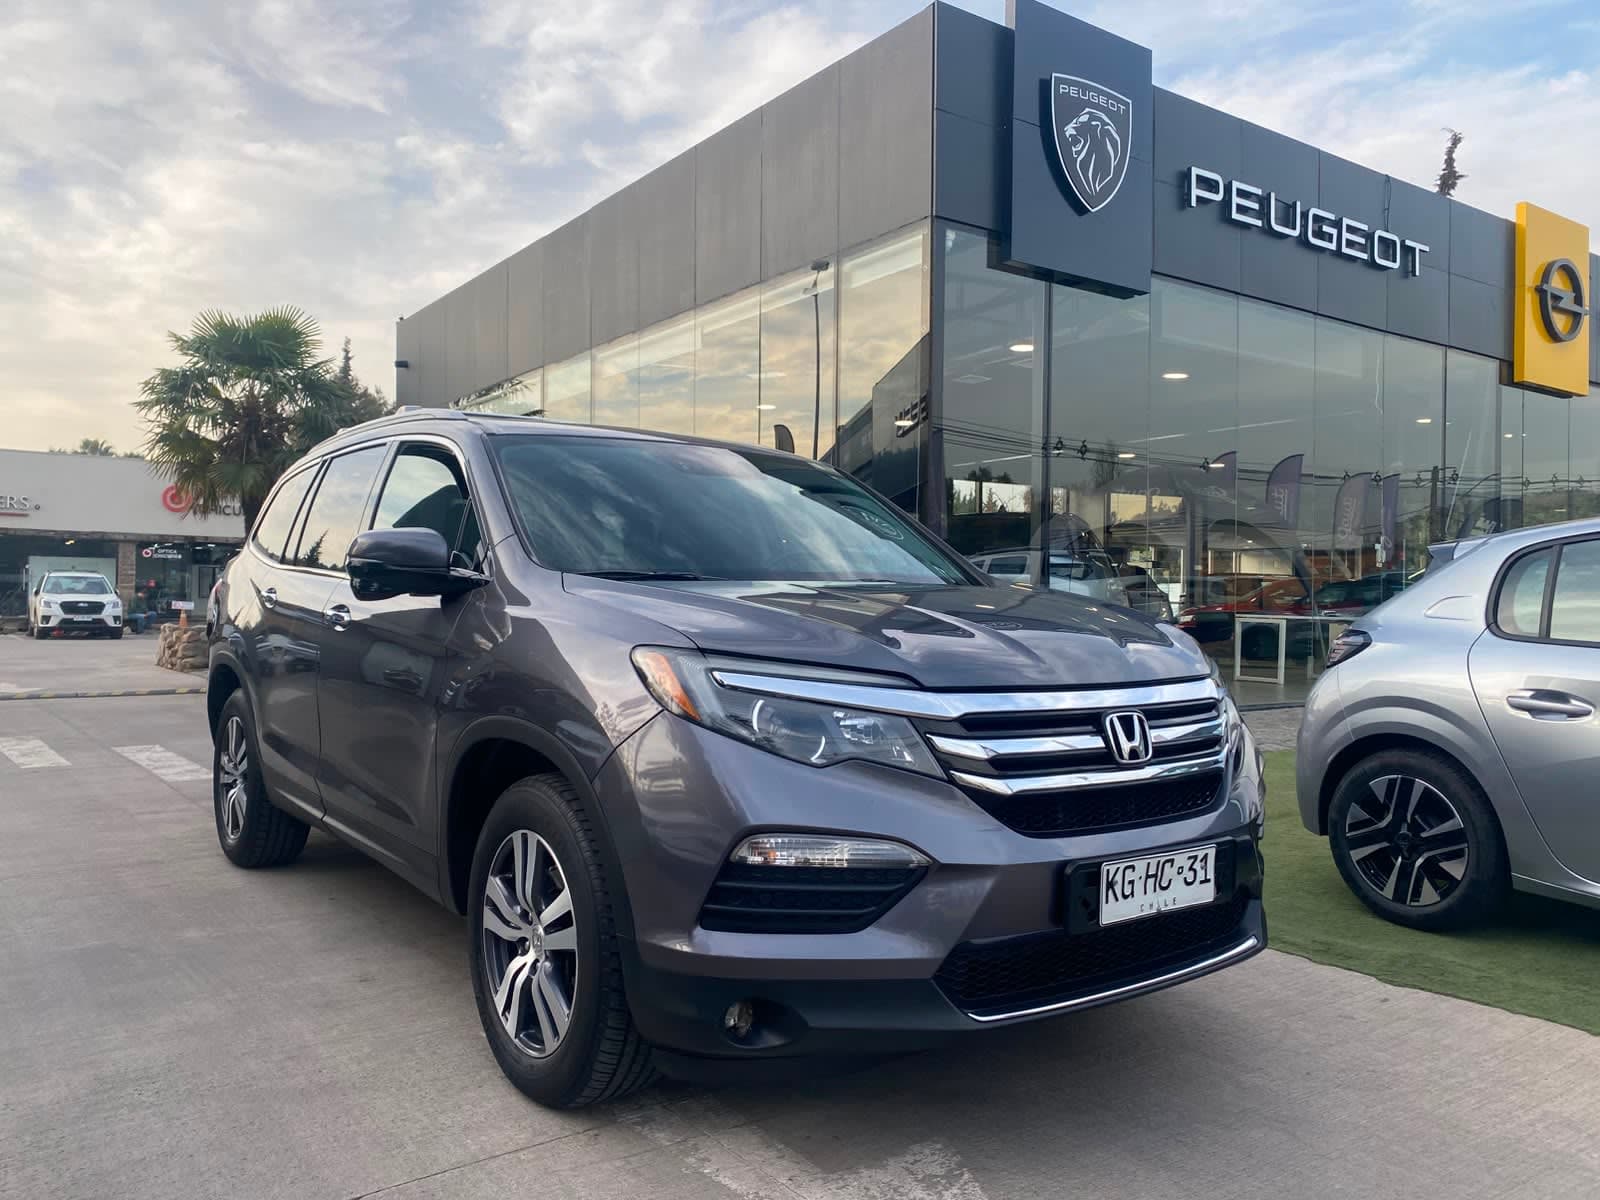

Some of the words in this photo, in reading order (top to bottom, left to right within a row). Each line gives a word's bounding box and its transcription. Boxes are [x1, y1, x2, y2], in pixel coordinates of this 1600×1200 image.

[1059, 83, 1126, 115] PEUGEOT
[1187, 165, 1430, 278] PEUGEOT
[1139, 896, 1178, 913] CHILE
